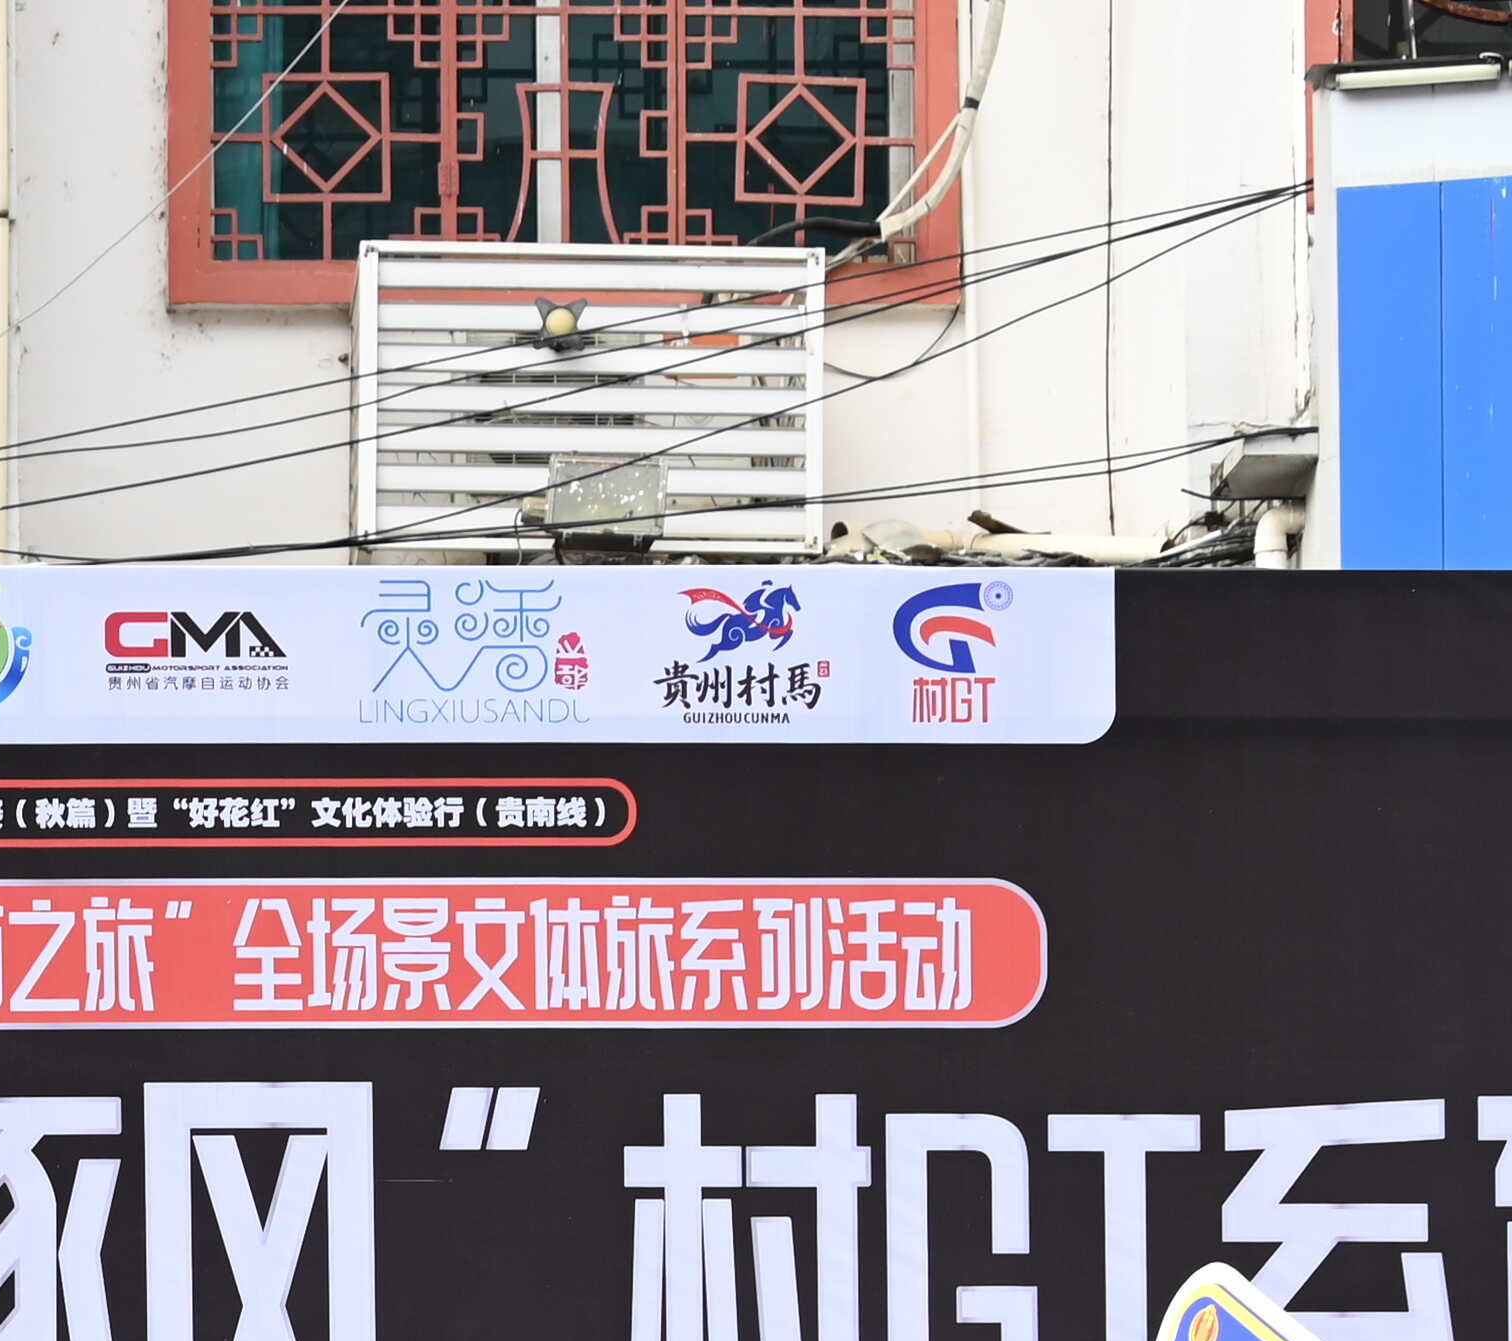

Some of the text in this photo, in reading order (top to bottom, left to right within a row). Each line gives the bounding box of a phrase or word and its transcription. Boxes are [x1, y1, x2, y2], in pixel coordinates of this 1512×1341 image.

[106, 663, 289, 673] GUIZHOU MOTORSPORT ASSOCIATION
[108, 675, 289, 691] 贵州省汽摩自运动协会
[912, 676, 998, 724] 村GT
[359, 698, 591, 724] LINGXIUSANDU
[682, 711, 791, 724] GUIZHOUCUNMA
